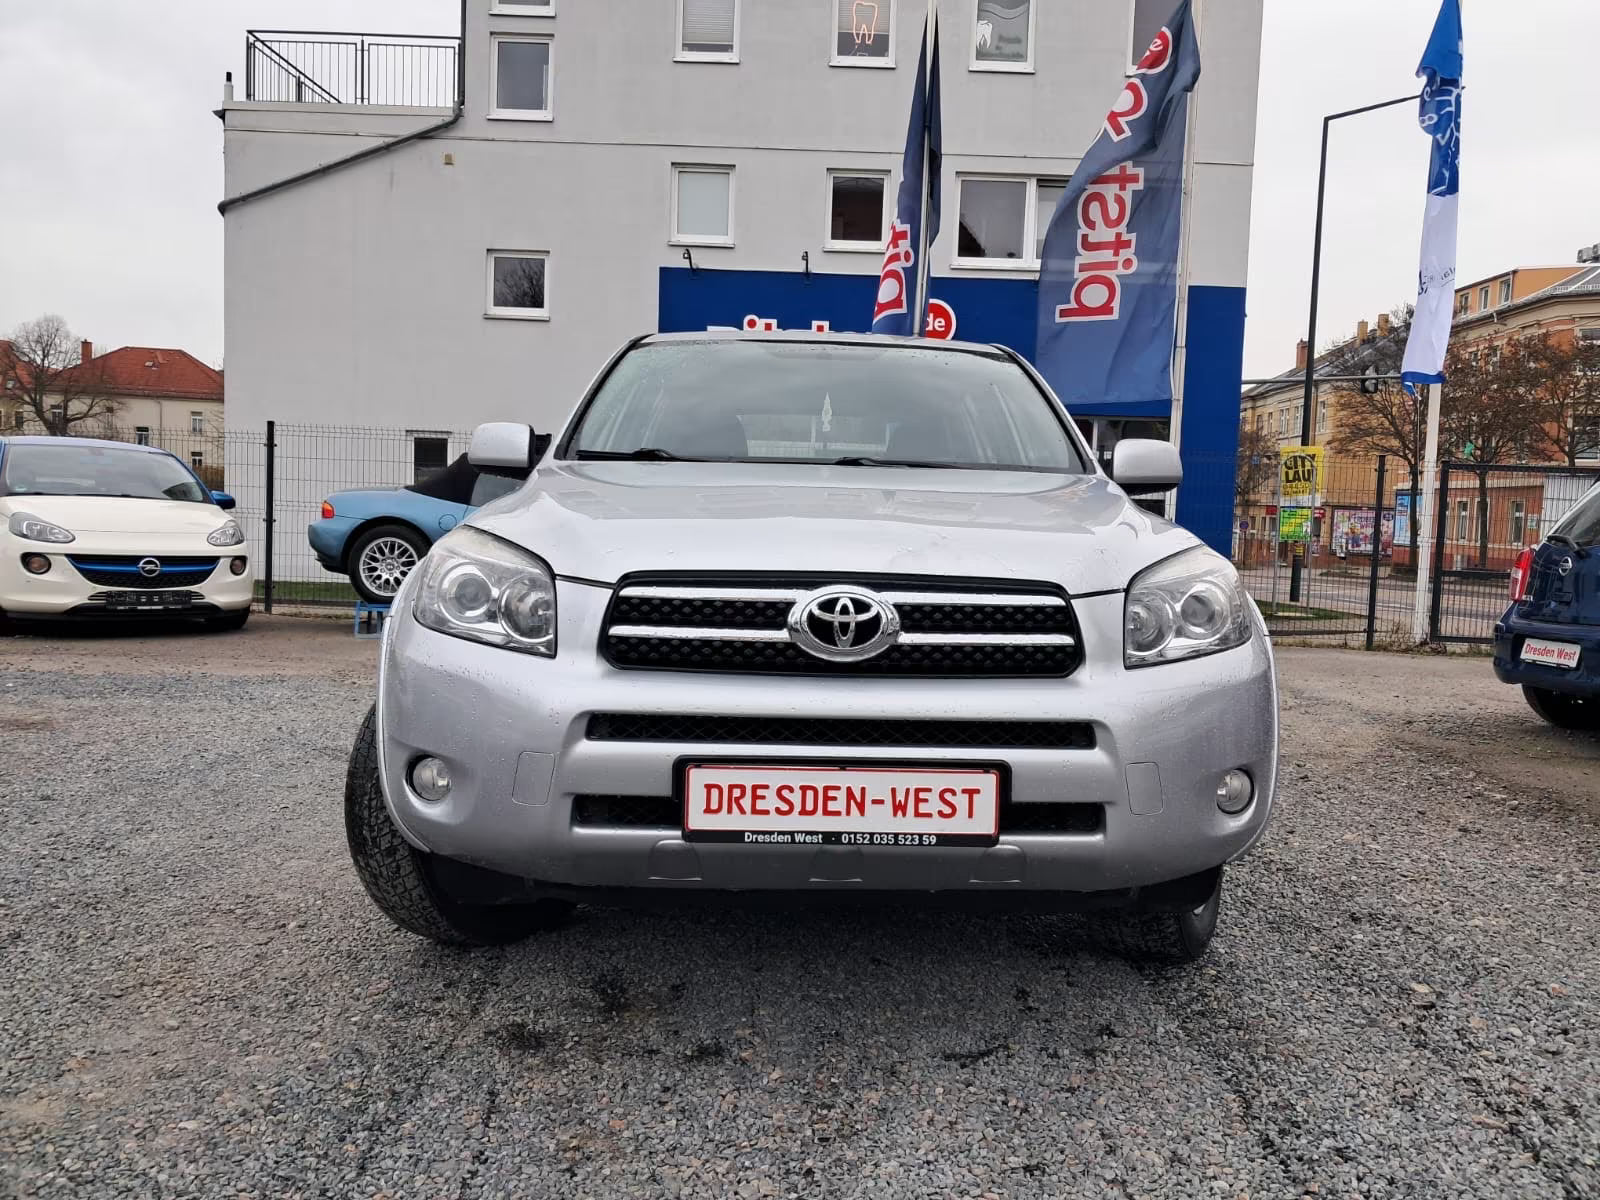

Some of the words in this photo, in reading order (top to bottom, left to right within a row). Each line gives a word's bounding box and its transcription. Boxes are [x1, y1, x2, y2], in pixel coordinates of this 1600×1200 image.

[1284, 454, 1316, 470] CITY
[1525, 643, 1555, 658] Dresden
[1556, 647, 1577, 661] West
[702, 783, 982, 819] DRESDEN-WEST
[744, 832, 791, 844] Dresden
[794, 832, 823, 844] West
[841, 833, 870, 845] 0152
[873, 833, 895, 845] 035
[897, 834, 920, 846] 523
[922, 834, 937, 846] 59
